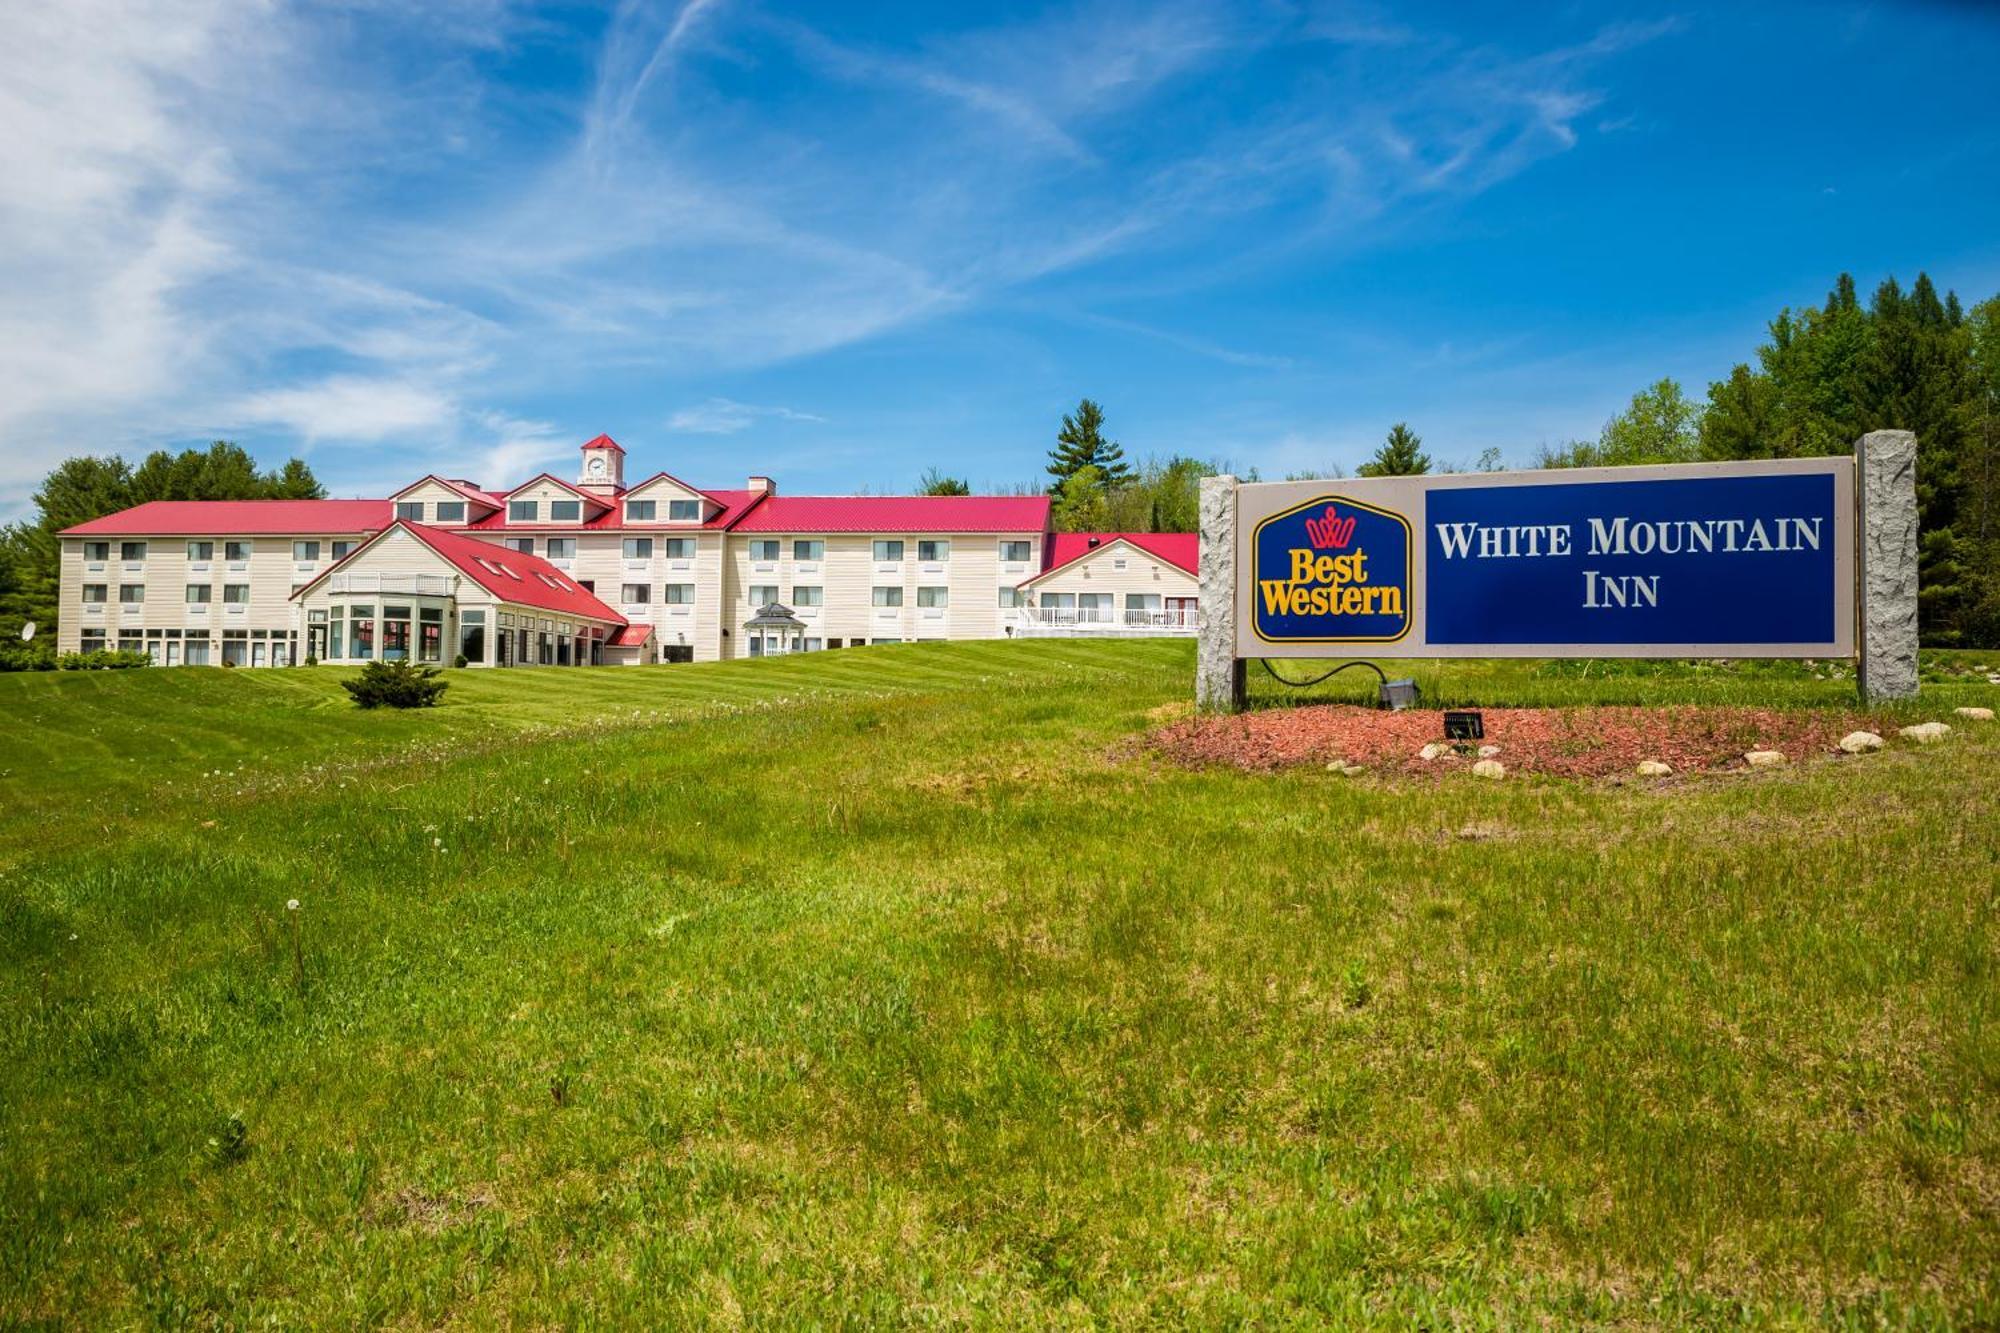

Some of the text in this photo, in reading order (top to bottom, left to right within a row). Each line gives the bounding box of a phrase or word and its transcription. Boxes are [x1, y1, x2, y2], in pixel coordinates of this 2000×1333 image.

[1434, 517, 1824, 559] WHITE MOUNTAIN
[1288, 548, 1368, 584] Best
[1260, 579, 1404, 616] Western
[1582, 570, 1660, 608] INN
